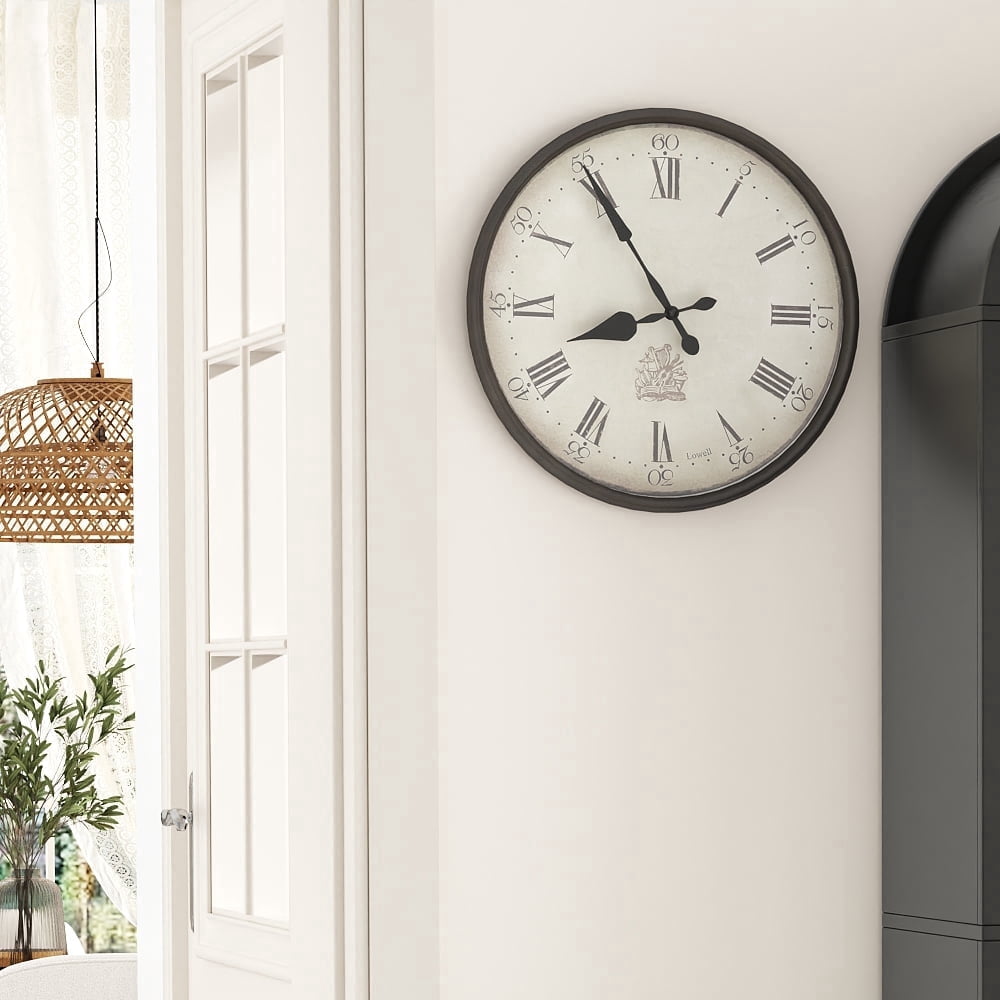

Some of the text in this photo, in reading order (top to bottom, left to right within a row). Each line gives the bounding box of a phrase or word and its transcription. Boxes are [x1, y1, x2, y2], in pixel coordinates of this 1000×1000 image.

[652, 134, 679, 150] 60
[571, 148, 594, 173] 55
[739, 161, 757, 176] 5
[648, 157, 681, 200] XII
[510, 206, 532, 235] 50
[793, 219, 816, 245] 10
[489, 291, 506, 318] 45
[817, 305, 834, 330] 15
[507, 377, 530, 400] 40
[791, 383, 814, 412] 20
[563, 440, 591, 464] 35
[686, 448, 713, 460] Lowell
[729, 445, 754, 472] 25
[647, 469, 674, 486] 30
